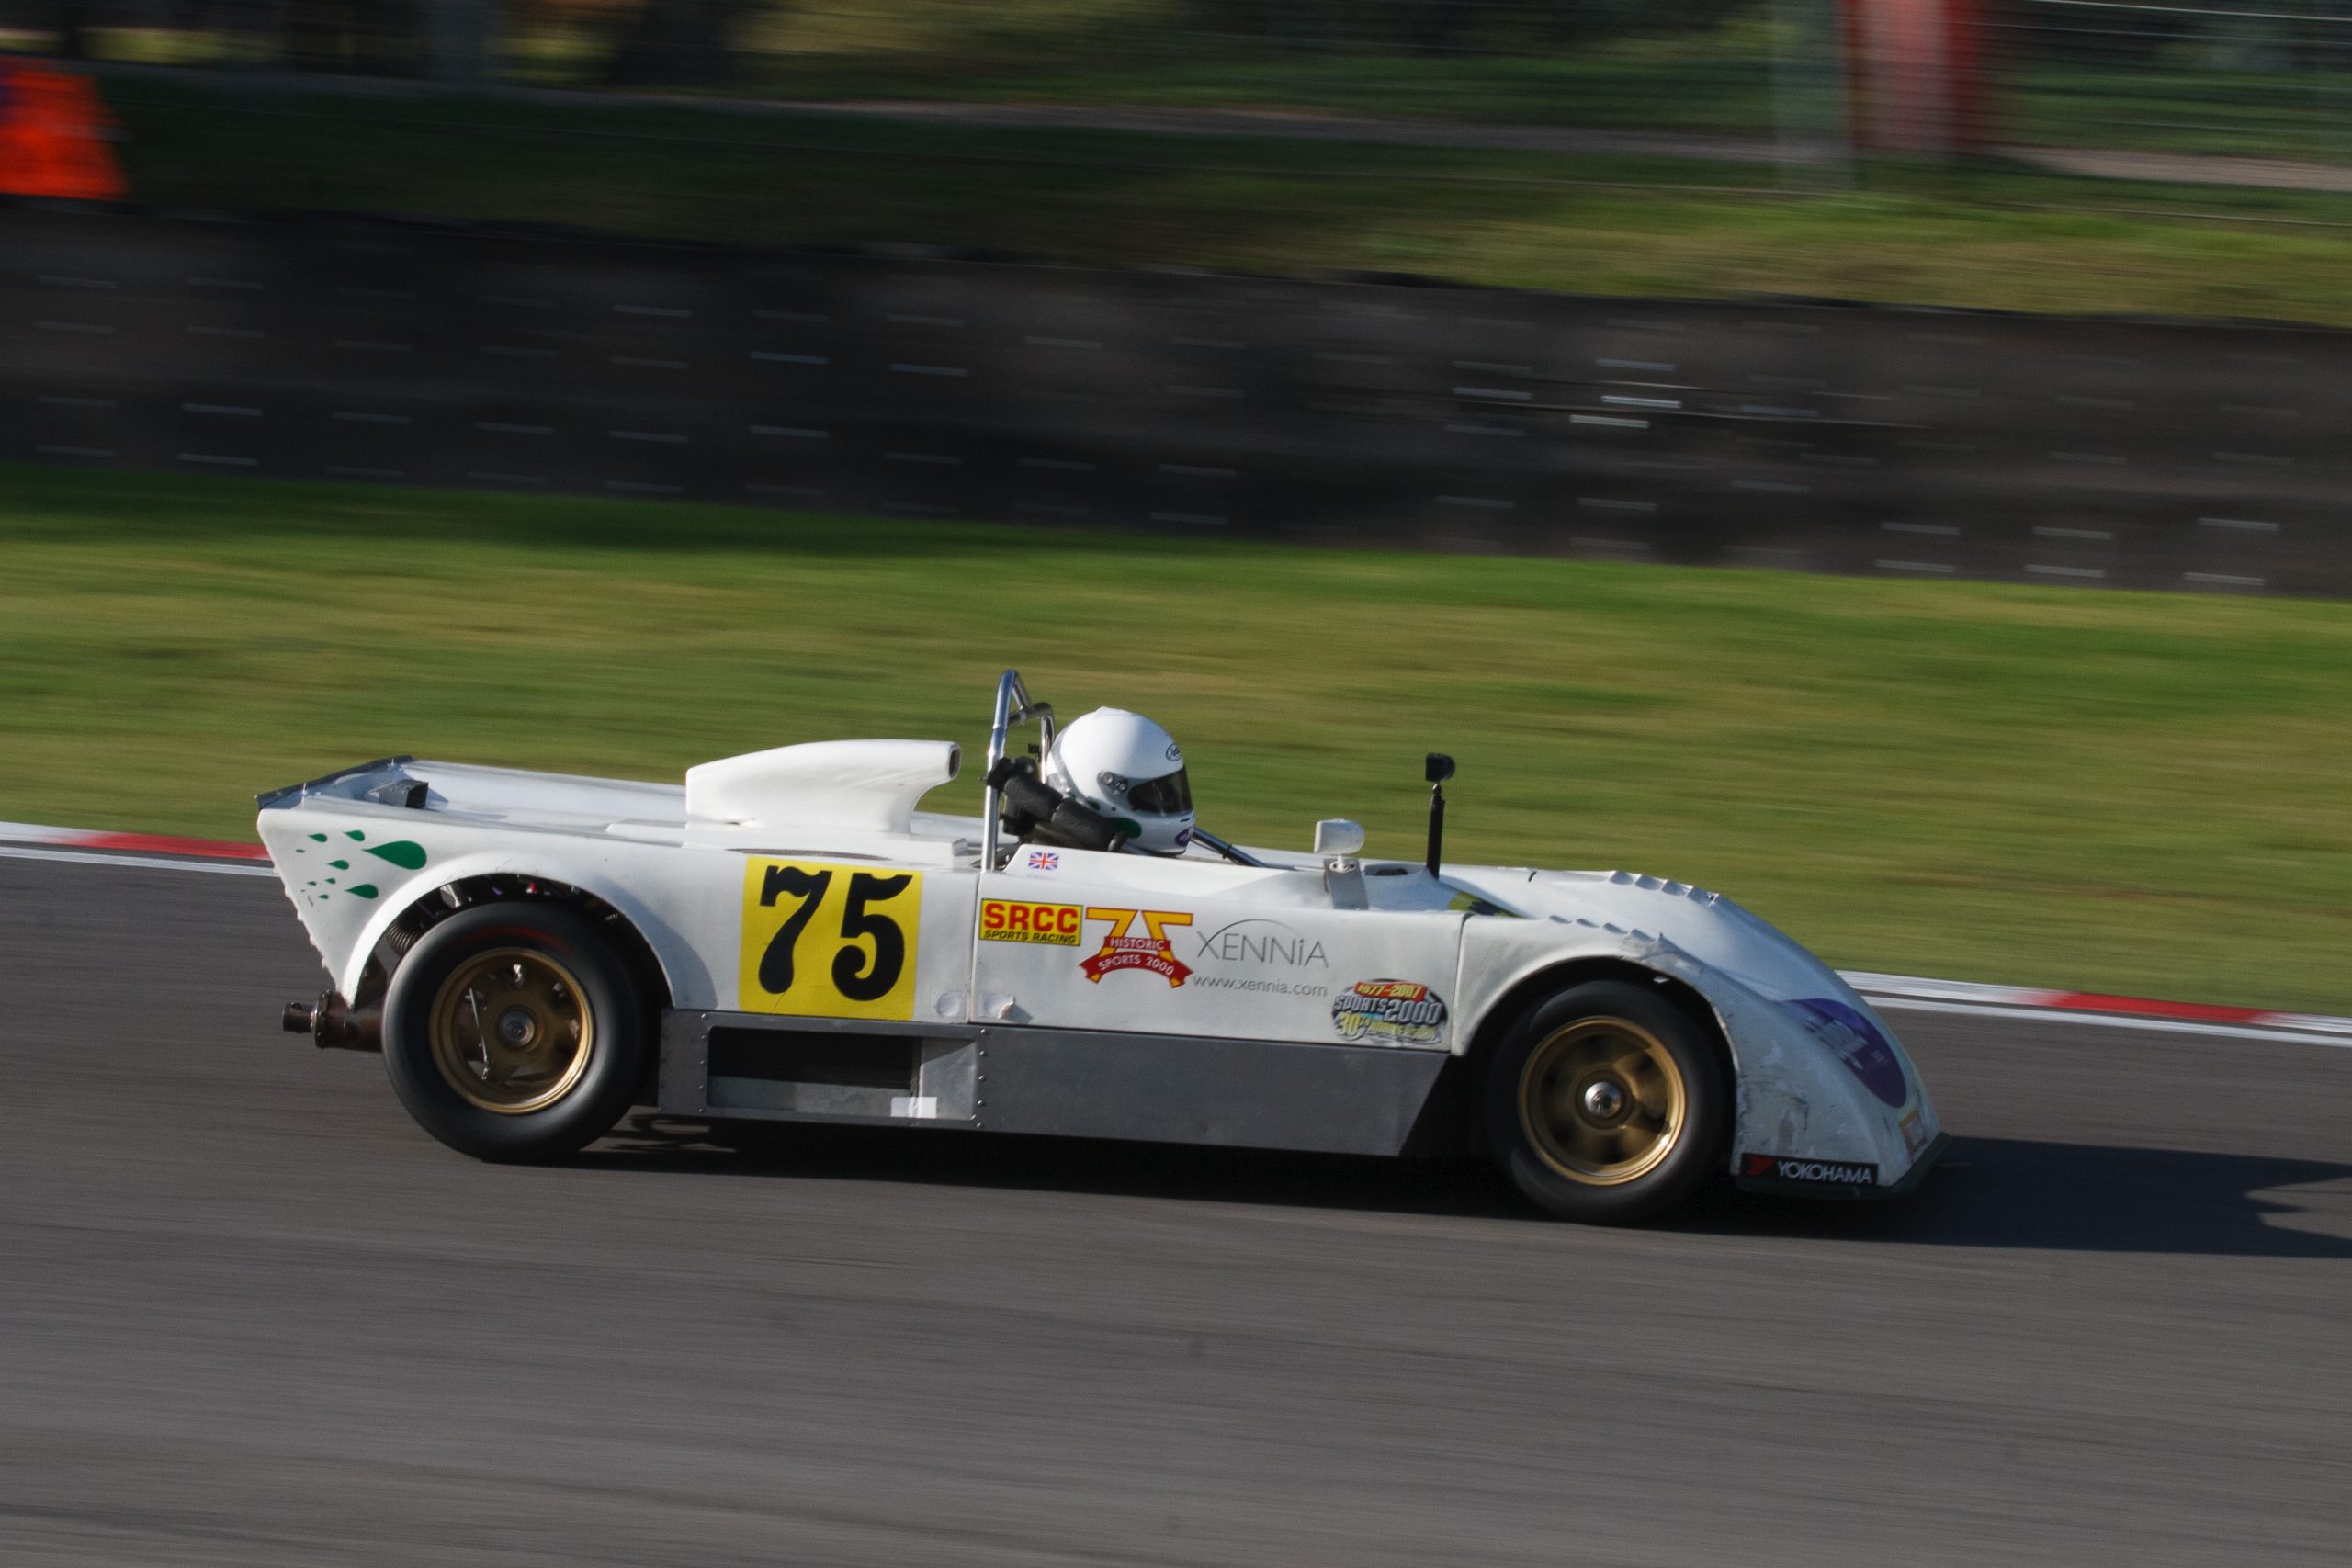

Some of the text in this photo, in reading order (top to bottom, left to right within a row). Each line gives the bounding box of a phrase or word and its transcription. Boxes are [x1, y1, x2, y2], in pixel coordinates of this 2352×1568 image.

[984, 903, 1079, 934] SRCC
[758, 865, 913, 1001] 75
[984, 930, 1076, 944] SPORTS RACING
[1109, 938, 1166, 951] HISTORIC
[1098, 955, 1175, 976] SPORTS 2000
[1193, 976, 1329, 997] www.xennia.com
[1384, 998, 1443, 1025] 2000
[1777, 1161, 1871, 1184] YOKOHAMA
